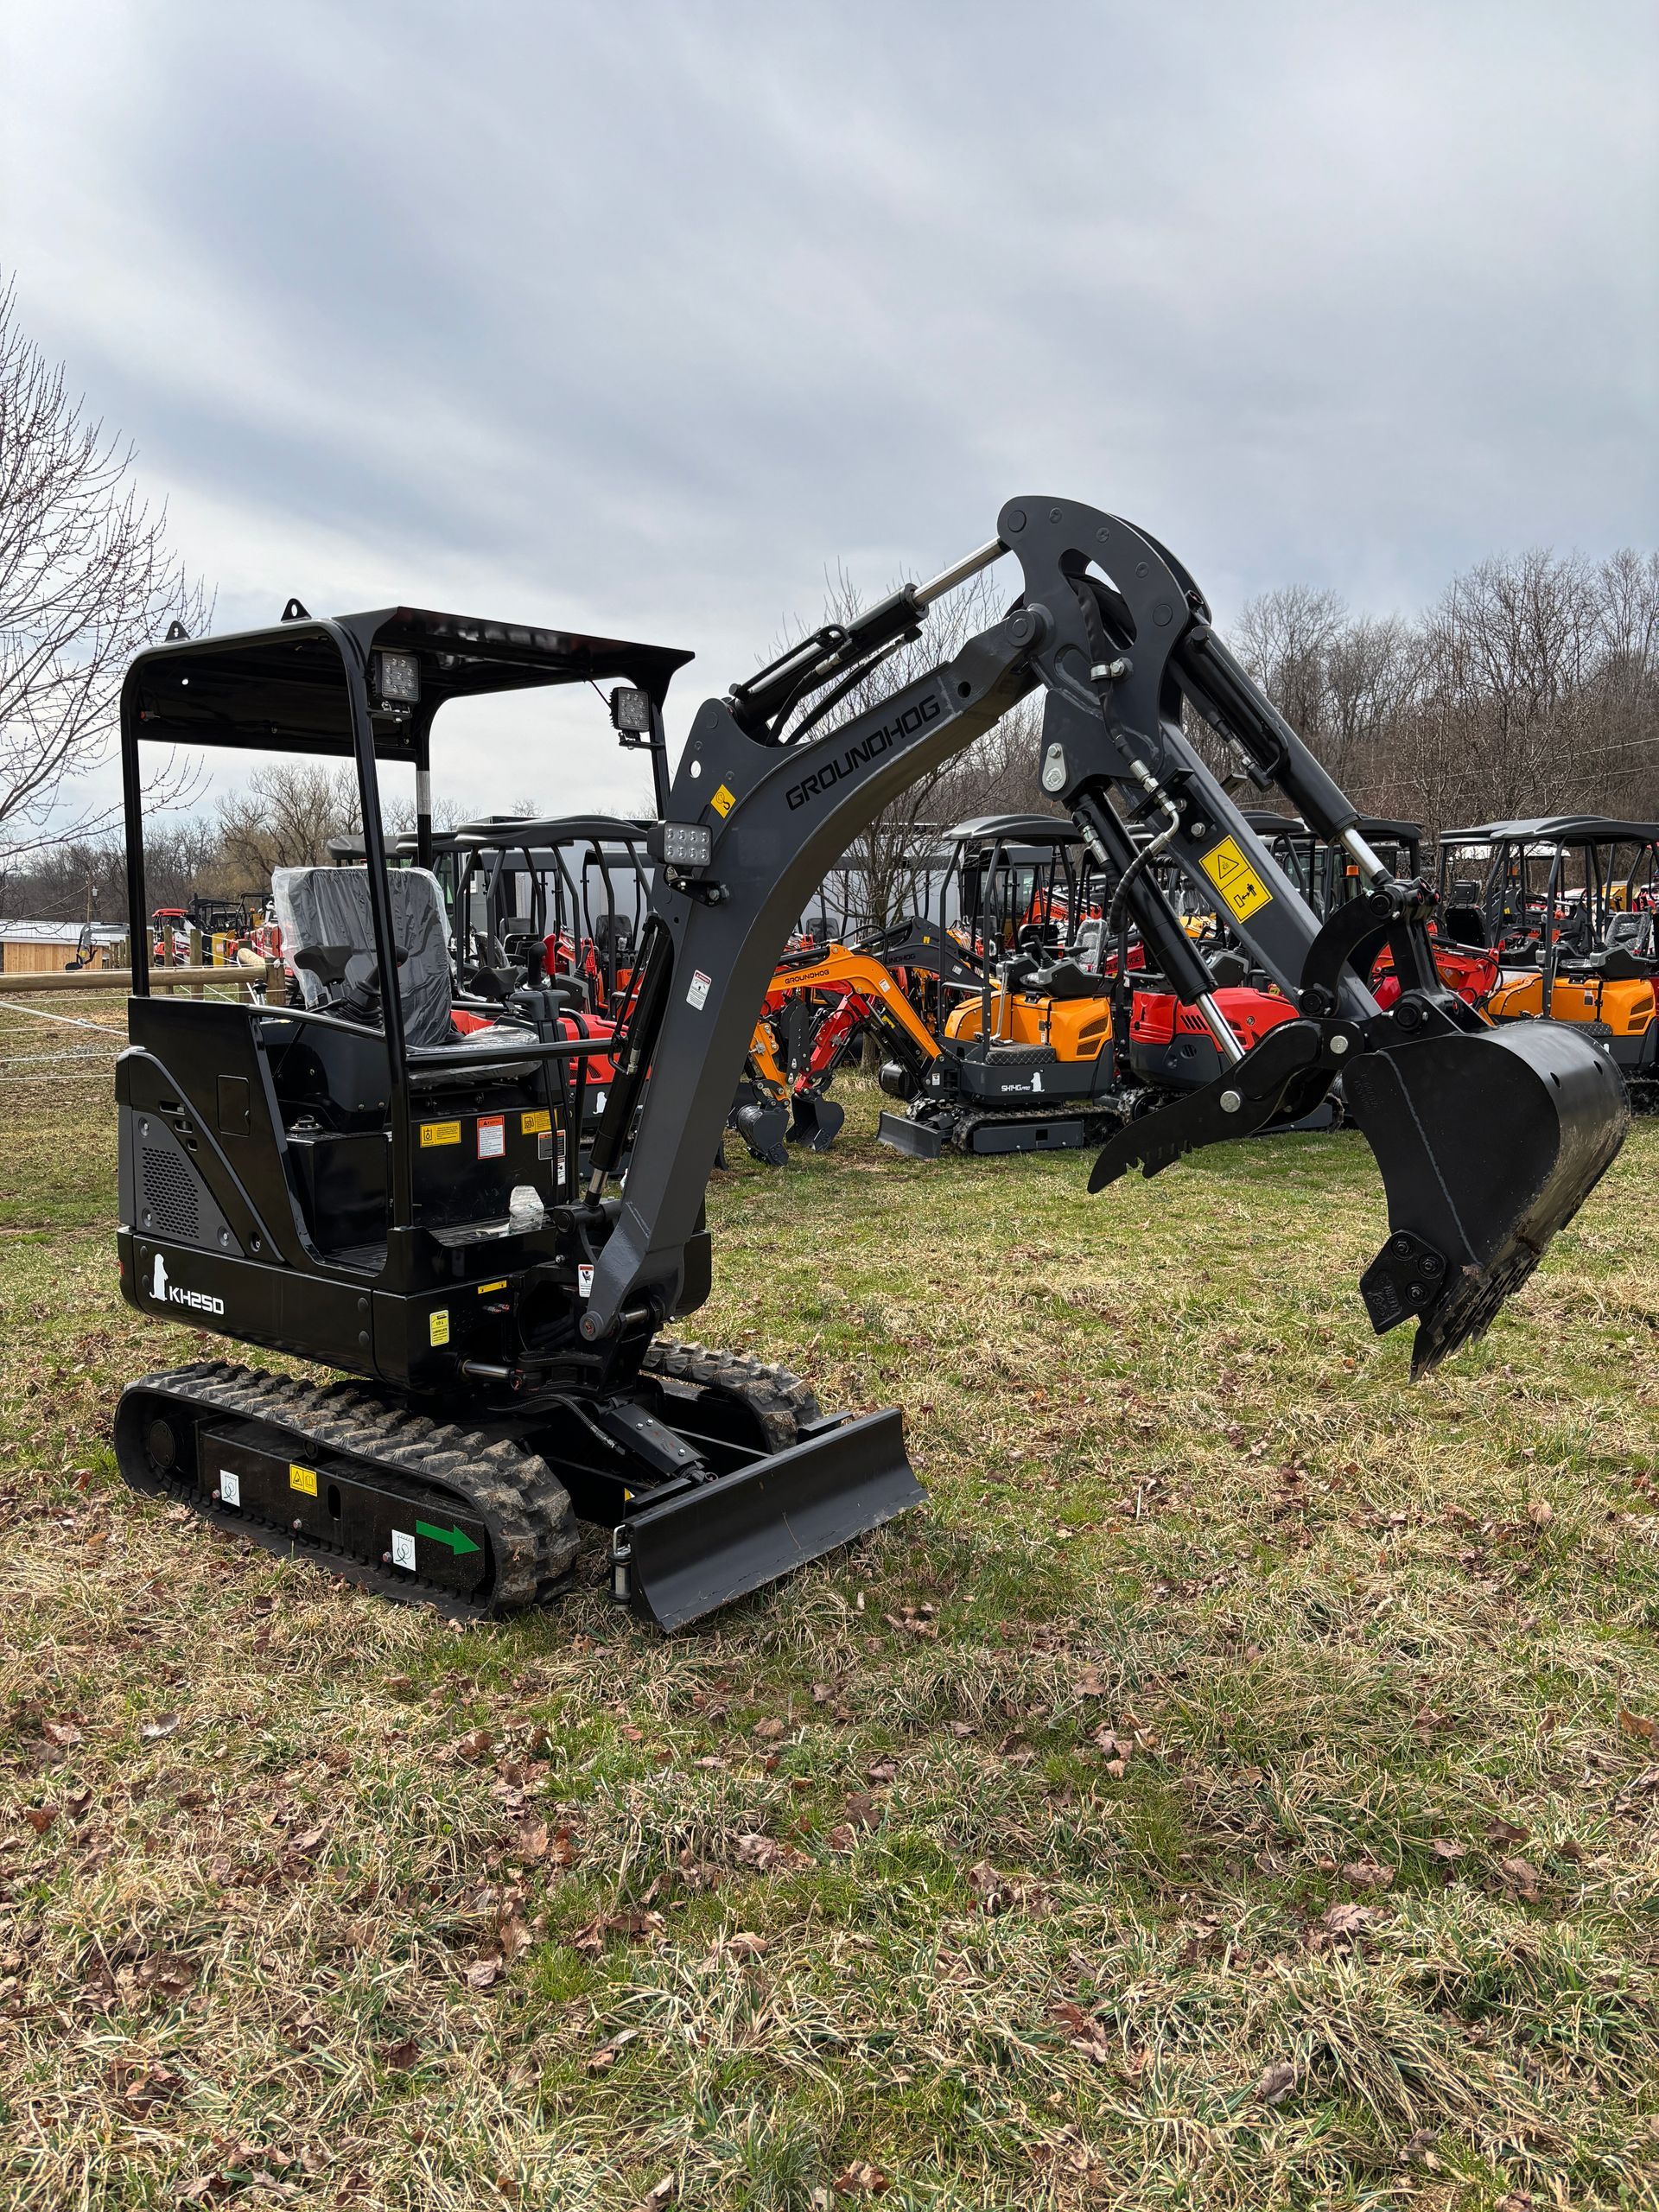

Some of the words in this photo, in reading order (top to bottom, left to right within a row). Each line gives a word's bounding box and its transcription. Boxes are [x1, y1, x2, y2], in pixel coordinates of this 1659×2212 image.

[785, 695, 941, 810] GROUNDHOG
[785, 969, 830, 984] GROUNDHOG
[168, 1285, 225, 1315] KH250
